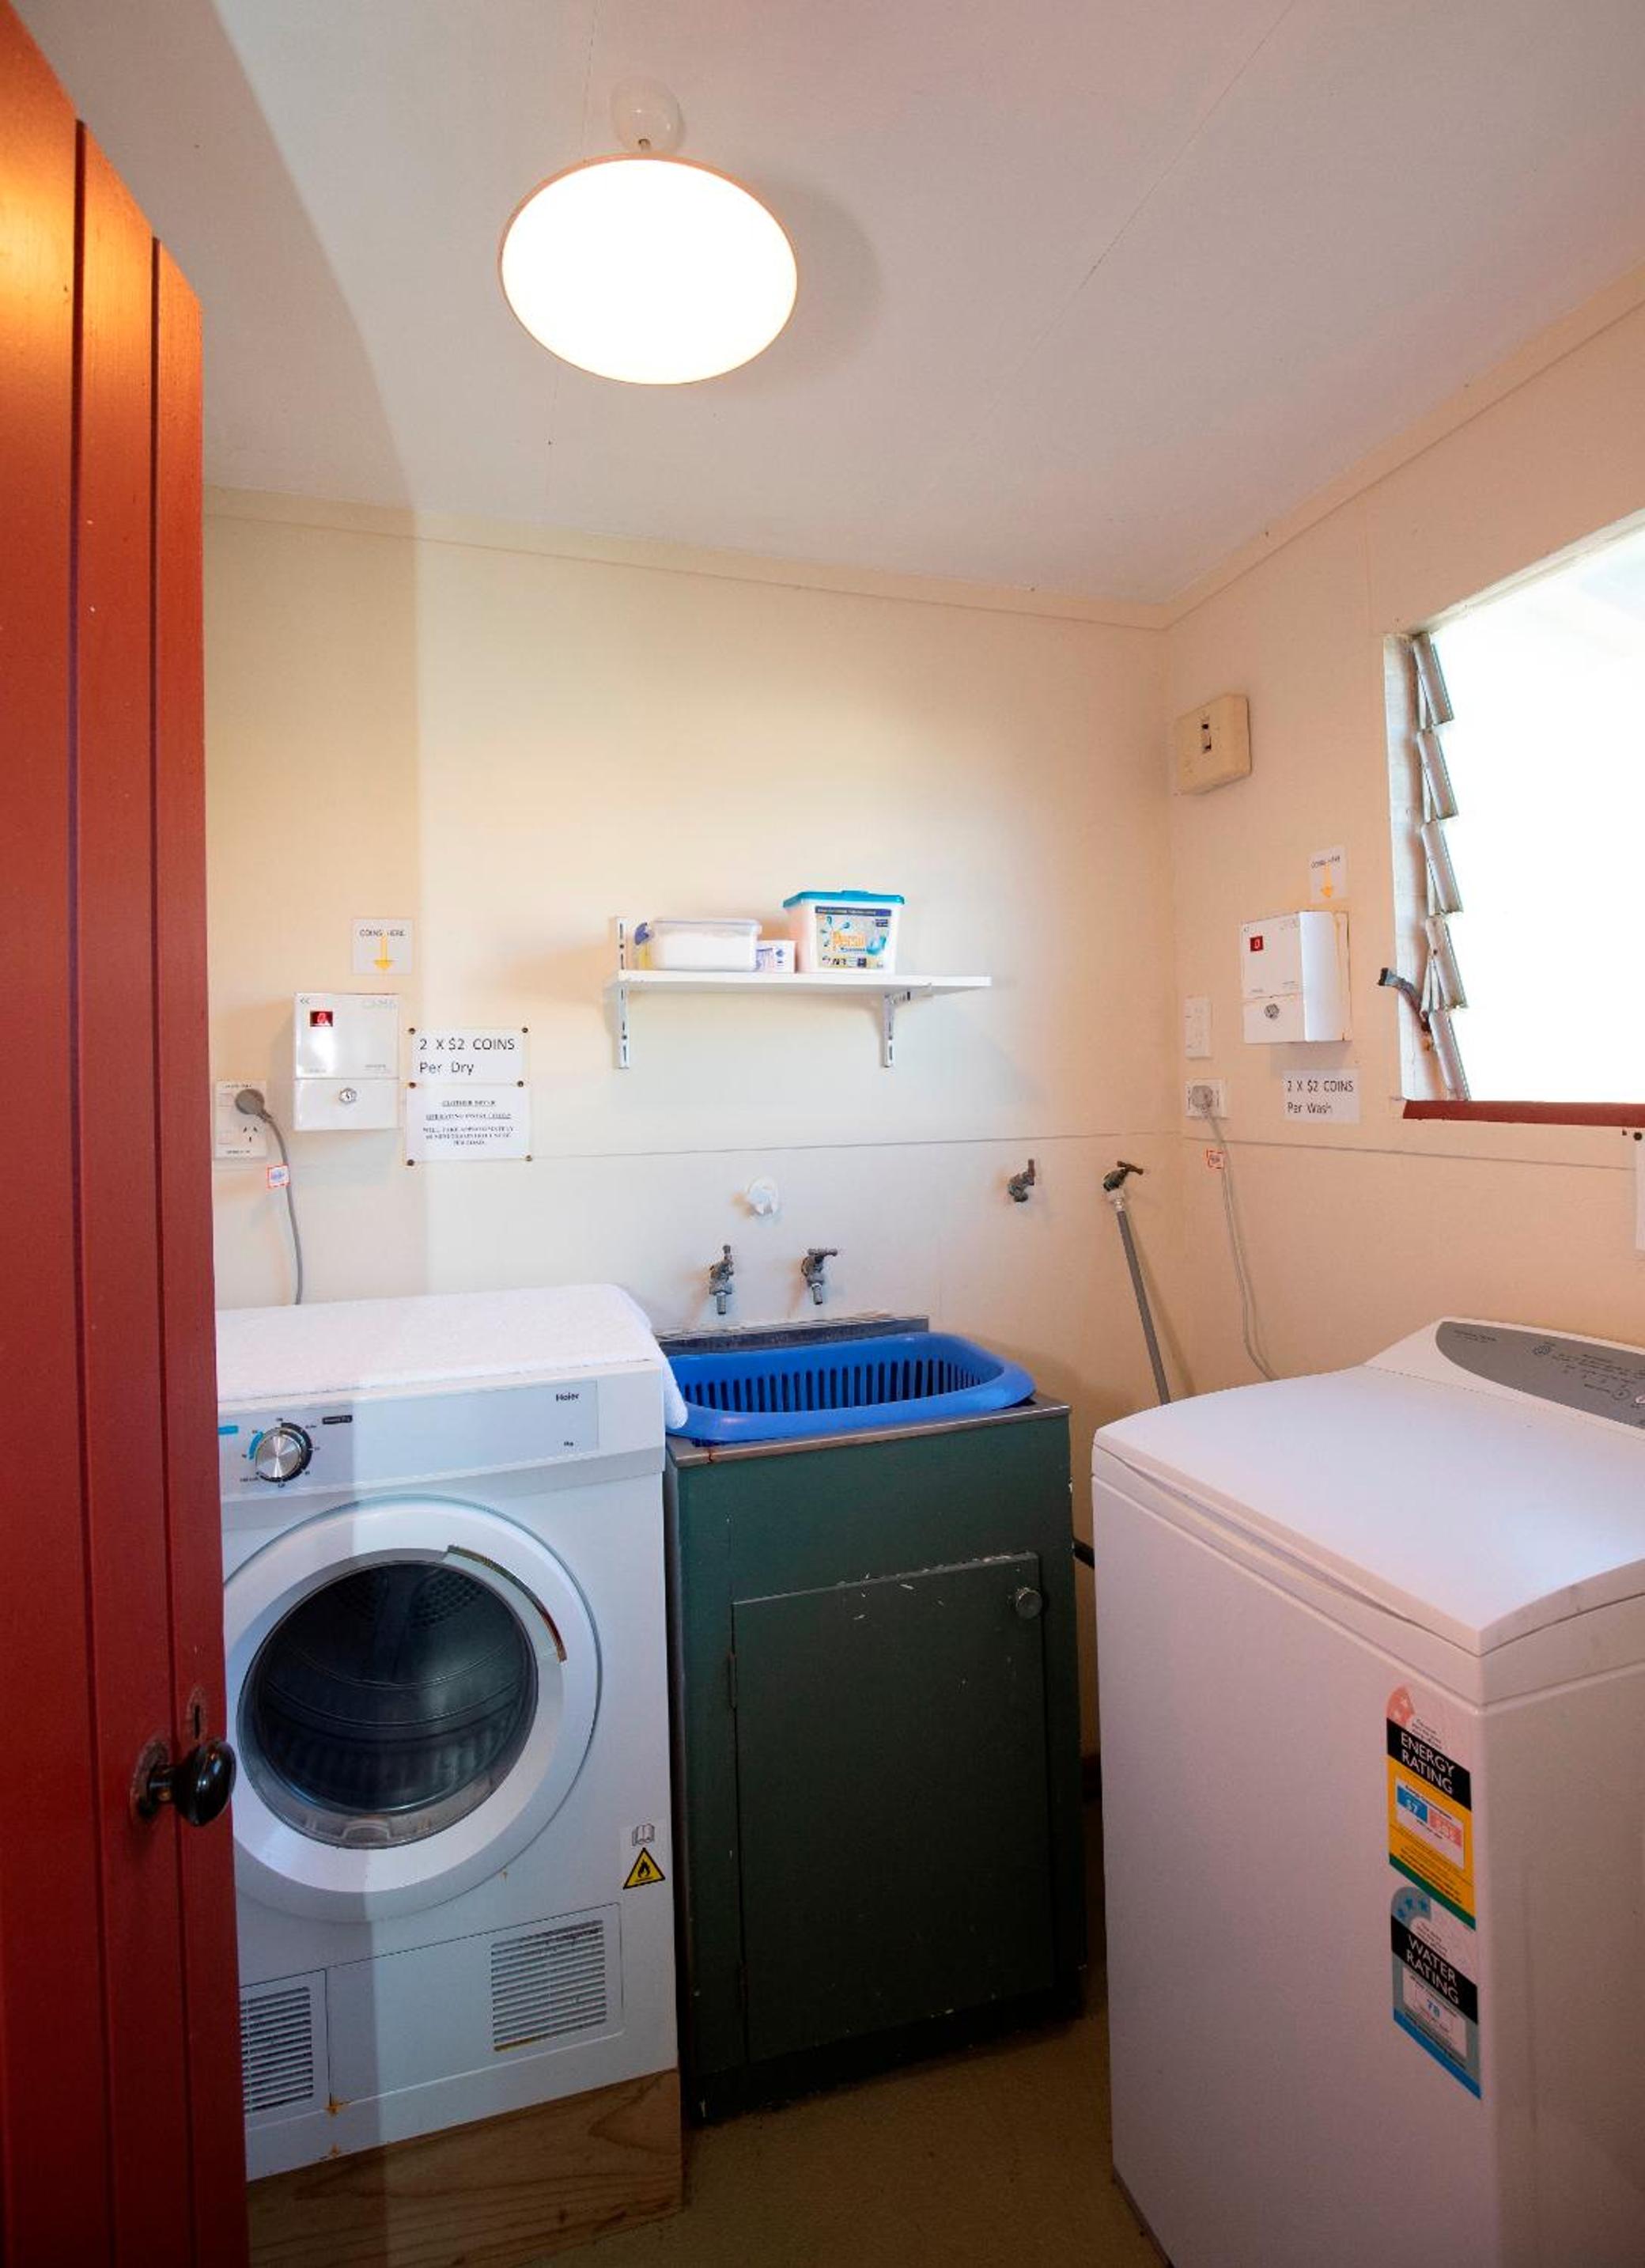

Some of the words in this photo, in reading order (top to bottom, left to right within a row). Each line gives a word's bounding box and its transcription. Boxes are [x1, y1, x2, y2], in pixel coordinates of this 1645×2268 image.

[420, 1038, 427, 1051] 2
[436, 1038, 444, 1051] X
[448, 1037, 464, 1052] $2
[473, 1038, 515, 1051] COINS
[420, 1062, 442, 1073] Per
[452, 1061, 475, 1076] Dry
[1288, 1081, 1291, 1092] 2
[1297, 1081, 1303, 1092] X
[1307, 1079, 1318, 1093] $2
[1324, 1081, 1353, 1092] COINS
[1288, 1102, 1303, 1113] Per
[1307, 1102, 1333, 1113] Wash
[556, 1392, 580, 1402] Haier
[1401, 1732, 1455, 1778] ENERGY
[1402, 1749, 1453, 1795] RATING
[1407, 1933, 1457, 1988] WATER
[1406, 1949, 1460, 2005] RATING
